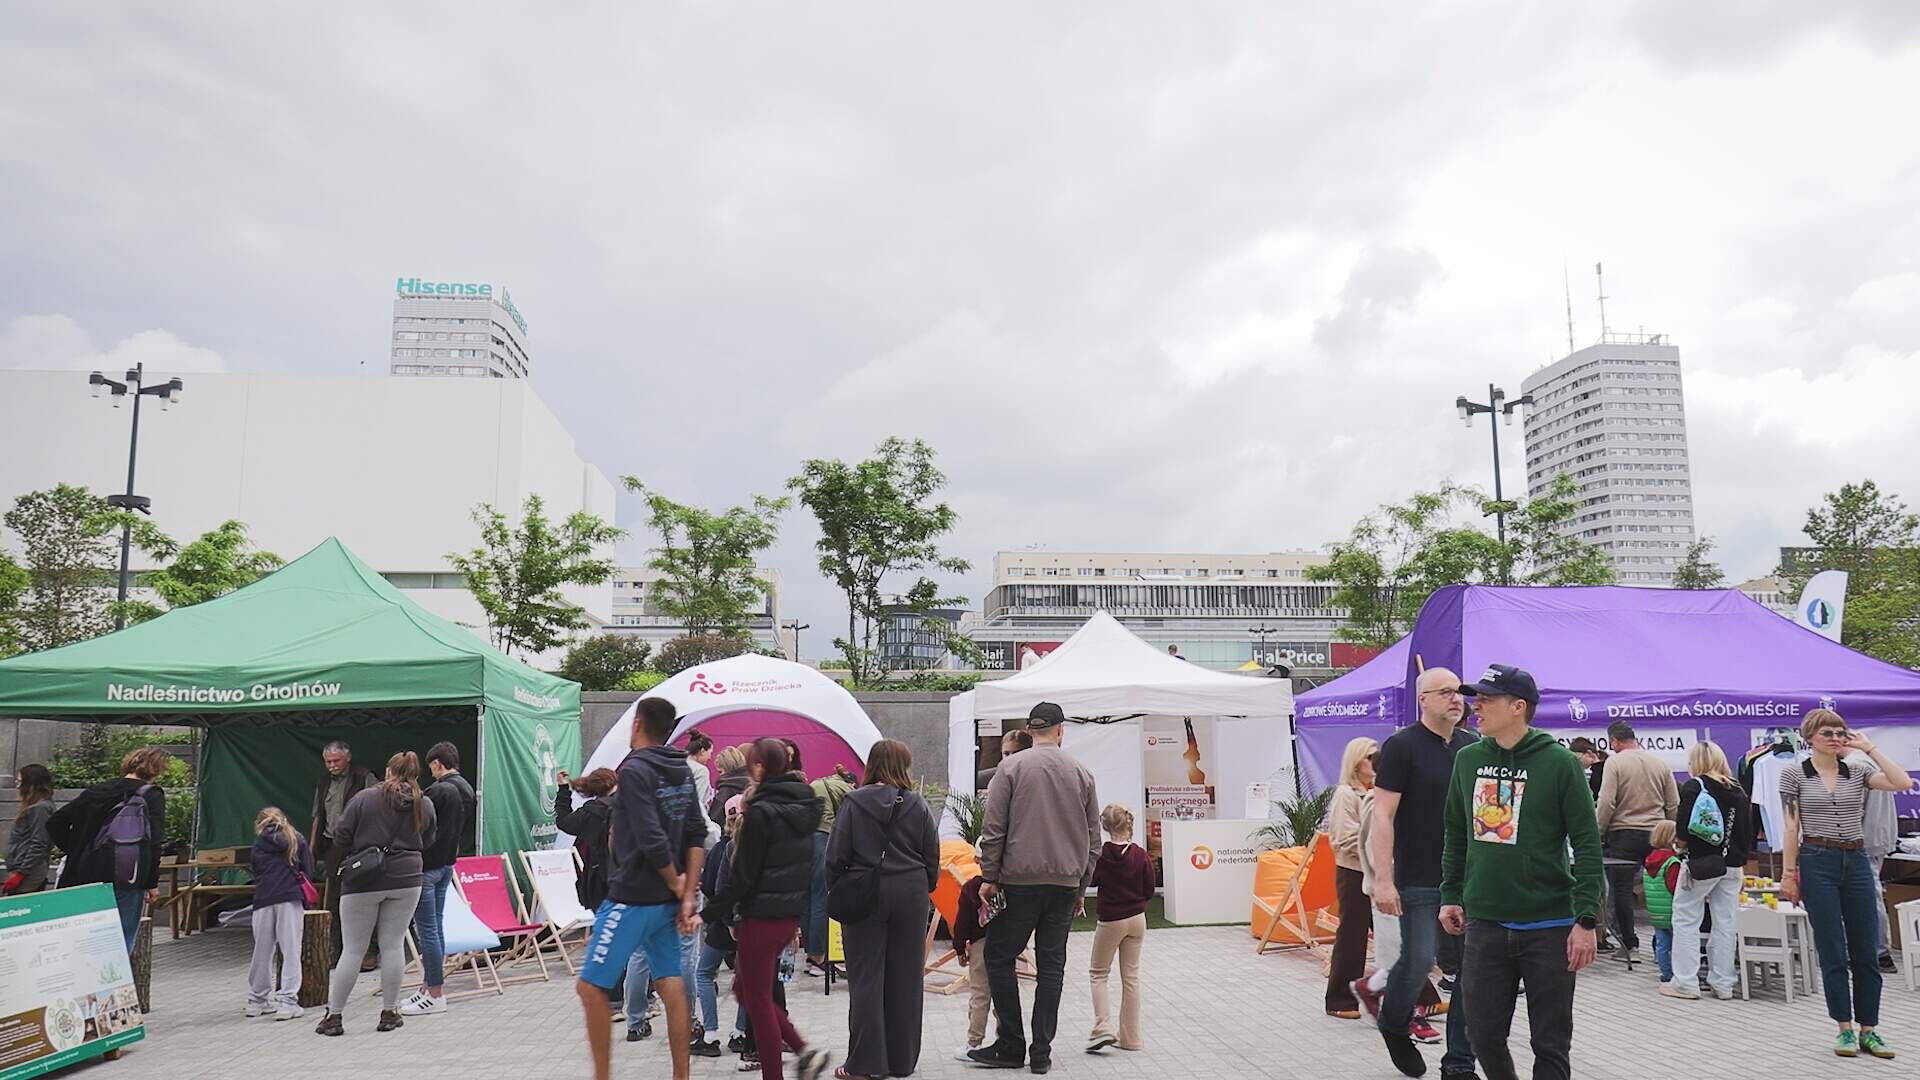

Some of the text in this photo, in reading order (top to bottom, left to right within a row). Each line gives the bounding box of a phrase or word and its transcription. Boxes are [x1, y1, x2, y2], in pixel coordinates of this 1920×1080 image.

[396, 277, 492, 295] Hisense
[1253, 649, 1325, 664] Hal Price
[981, 660, 1005, 669] Price
[107, 680, 341, 702] Nadleśnictwo Chojnów
[1607, 700, 1800, 718] DZIELNICA ŚRÓDMIEŚCIE
[1151, 796, 1208, 806] psychicznego
[1217, 848, 1254, 856] nationale
[1217, 856, 1258, 864] nederland
